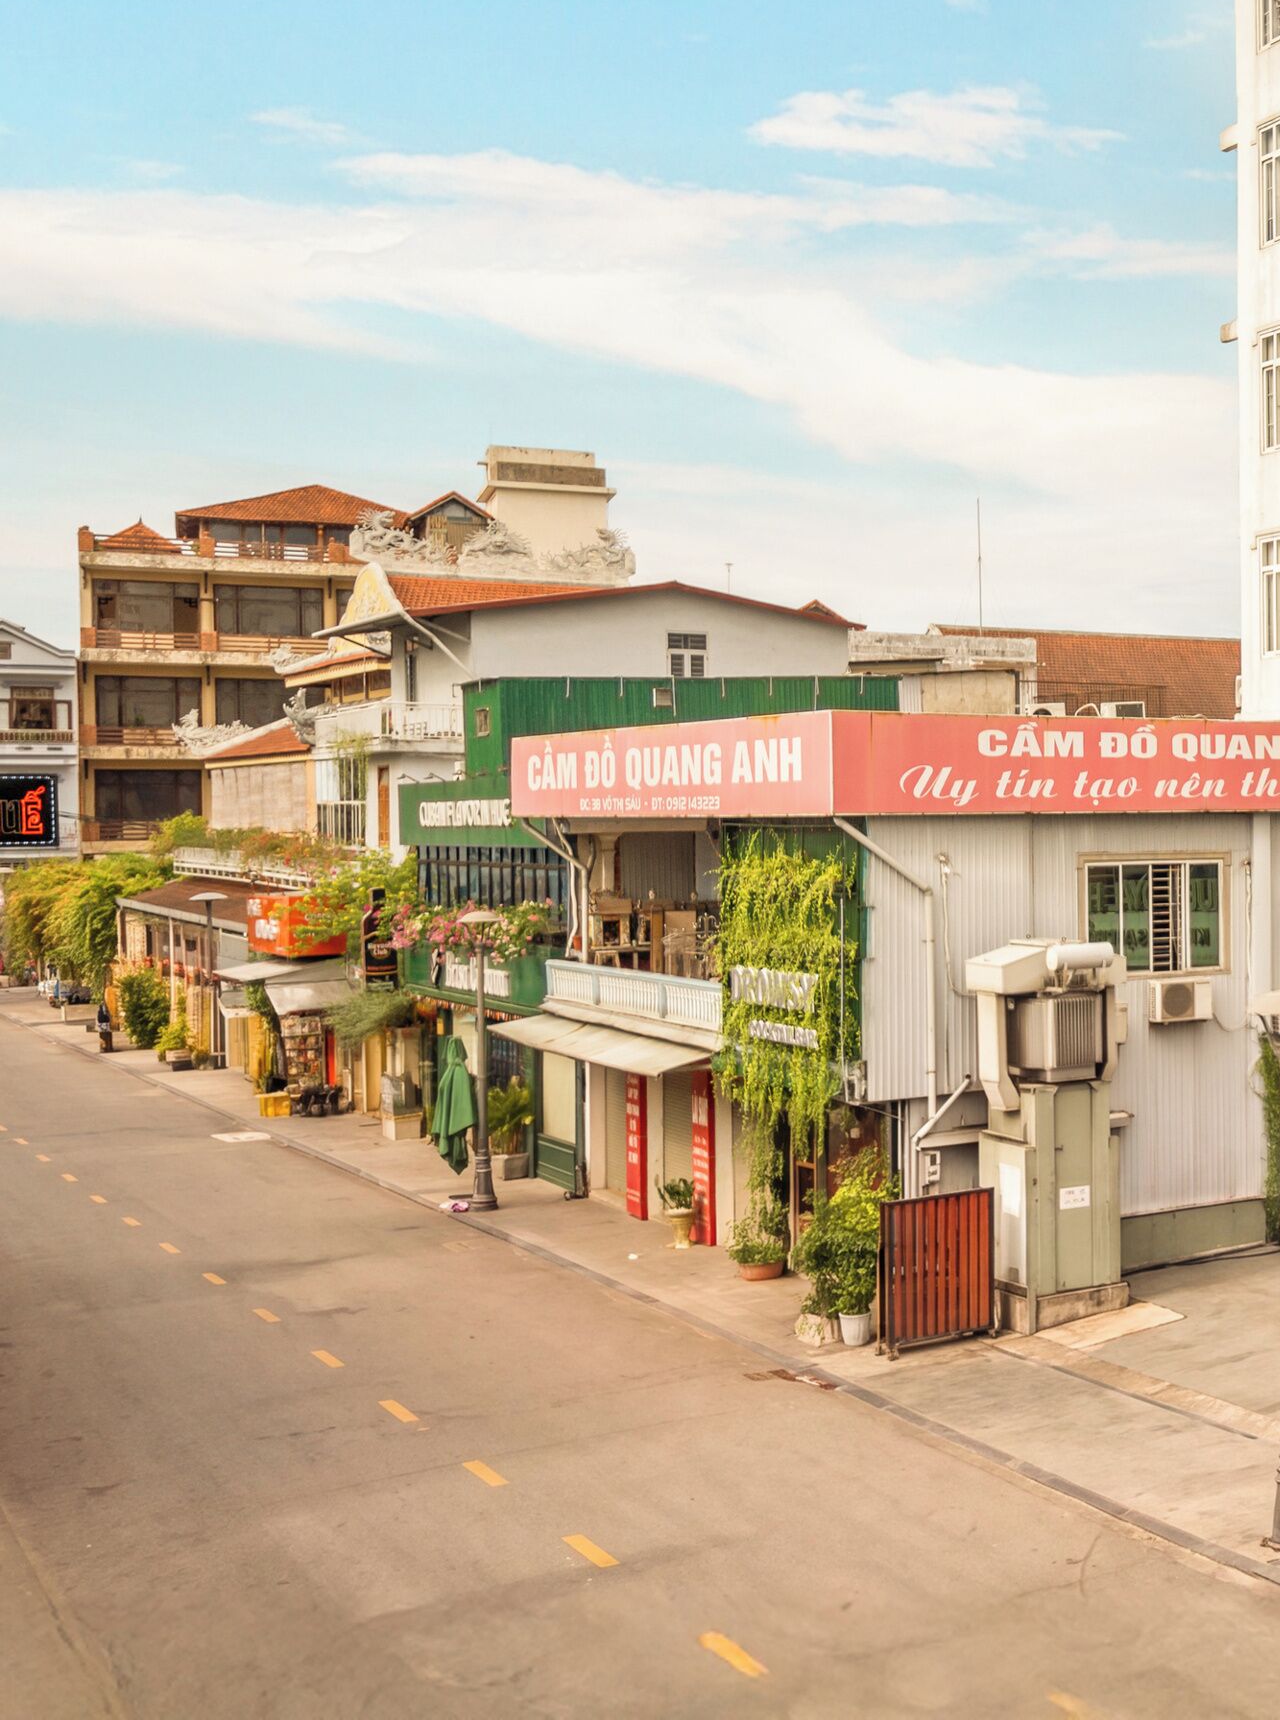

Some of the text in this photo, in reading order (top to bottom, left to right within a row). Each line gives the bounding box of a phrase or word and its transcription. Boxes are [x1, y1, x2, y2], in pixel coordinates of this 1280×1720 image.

[978, 721, 1084, 758] CẦM
[1099, 724, 1158, 759] ĐỒ
[527, 734, 803, 792] CẦM ĐỒ QUANG ANH
[899, 765, 980, 807] Uy
[995, 769, 1058, 799] tín
[1073, 770, 1142, 806] tạo
[1154, 773, 1228, 798] nên
